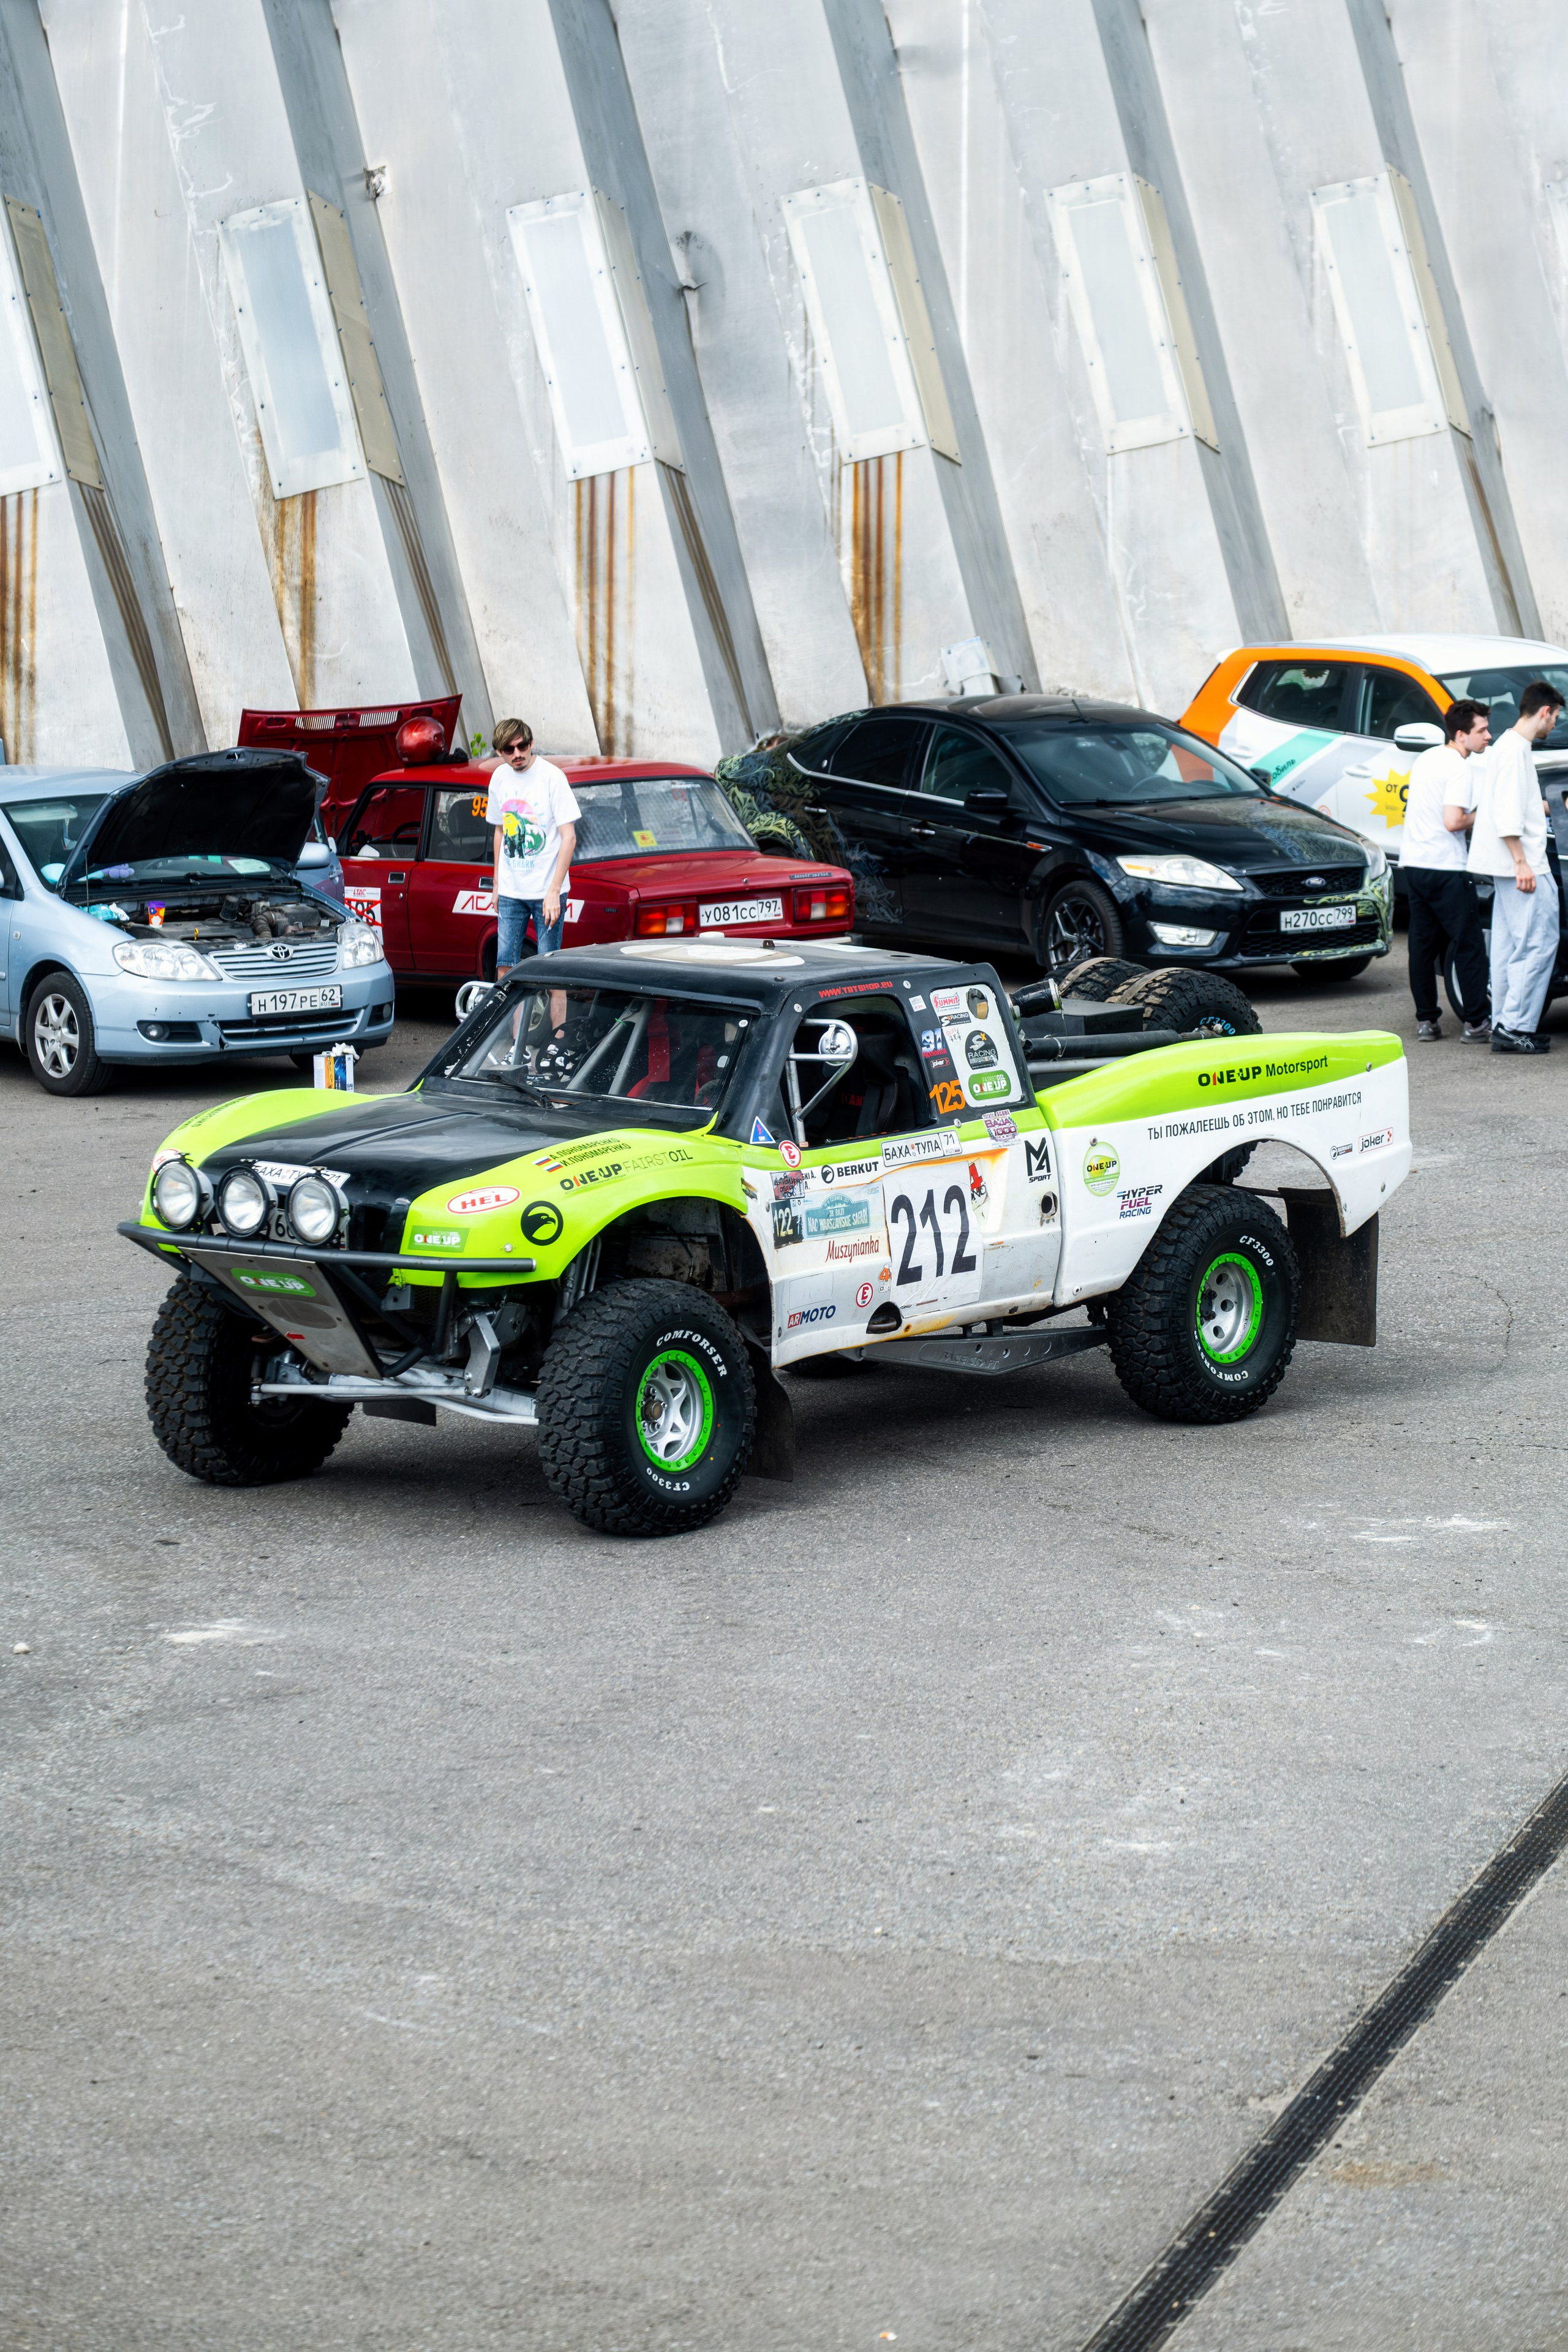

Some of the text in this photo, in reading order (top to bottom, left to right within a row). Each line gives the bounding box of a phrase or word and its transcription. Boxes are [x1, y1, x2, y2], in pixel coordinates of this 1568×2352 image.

[1272, 759, 1296, 782] обиль
[759, 900, 778, 913] 797
[1336, 907, 1353, 919] 799
[321, 988, 336, 1001] 62
[1199, 1016, 1236, 1035] CF3300
[968, 1049, 996, 1059] RACING
[932, 1060, 944, 1068] joker
[1197, 1055, 1328, 1087] ONE UP Motorsport
[973, 1082, 993, 1093] ONE
[993, 1079, 1007, 1090] UP
[929, 1079, 966, 1115] 125
[984, 1118, 1012, 1128] BAJA
[1148, 1091, 1362, 1140] ТЫ ПОЖАЛЕЕШЬ ОБ ЭТОМ, НО ТЕБЕ ПОНРАВИТСЯ
[992, 1126, 1017, 1137] 1000
[549, 1137, 620, 1160] А.ПОНОМАРЕНКО
[884, 1134, 956, 1161] БАХА ТУЛА 71
[1360, 1134, 1384, 1152] joker
[560, 1142, 631, 1167] И.ПОНОМАРЕНКО
[254, 1166, 282, 1178] БАХА
[837, 1161, 878, 1177] BERKUT
[1087, 1160, 1117, 1172] ONE UP
[560, 1170, 599, 1191] ONE
[598, 1163, 622, 1178] UP
[1028, 1174, 1052, 1183] SPORT
[1117, 1184, 1163, 1200] HYPER
[461, 1194, 508, 1210] HEL
[1120, 1196, 1152, 1210] FUEL
[807, 1207, 869, 1233] NAC WARSZAWSKIE SAFARI
[835, 1208, 845, 1216] RAJD
[1119, 1206, 1152, 1219] RACING
[774, 1207, 794, 1238] 122
[413, 1234, 441, 1244] ONE
[441, 1235, 461, 1245] UP
[891, 1185, 977, 1287] 212
[825, 1235, 880, 1264] Muszynianka
[1239, 1235, 1274, 1266] CF3300
[239, 1276, 281, 1287] ONE
[656, 1330, 728, 1378] COMFORSER
[646, 1467, 690, 1491] CF3300
